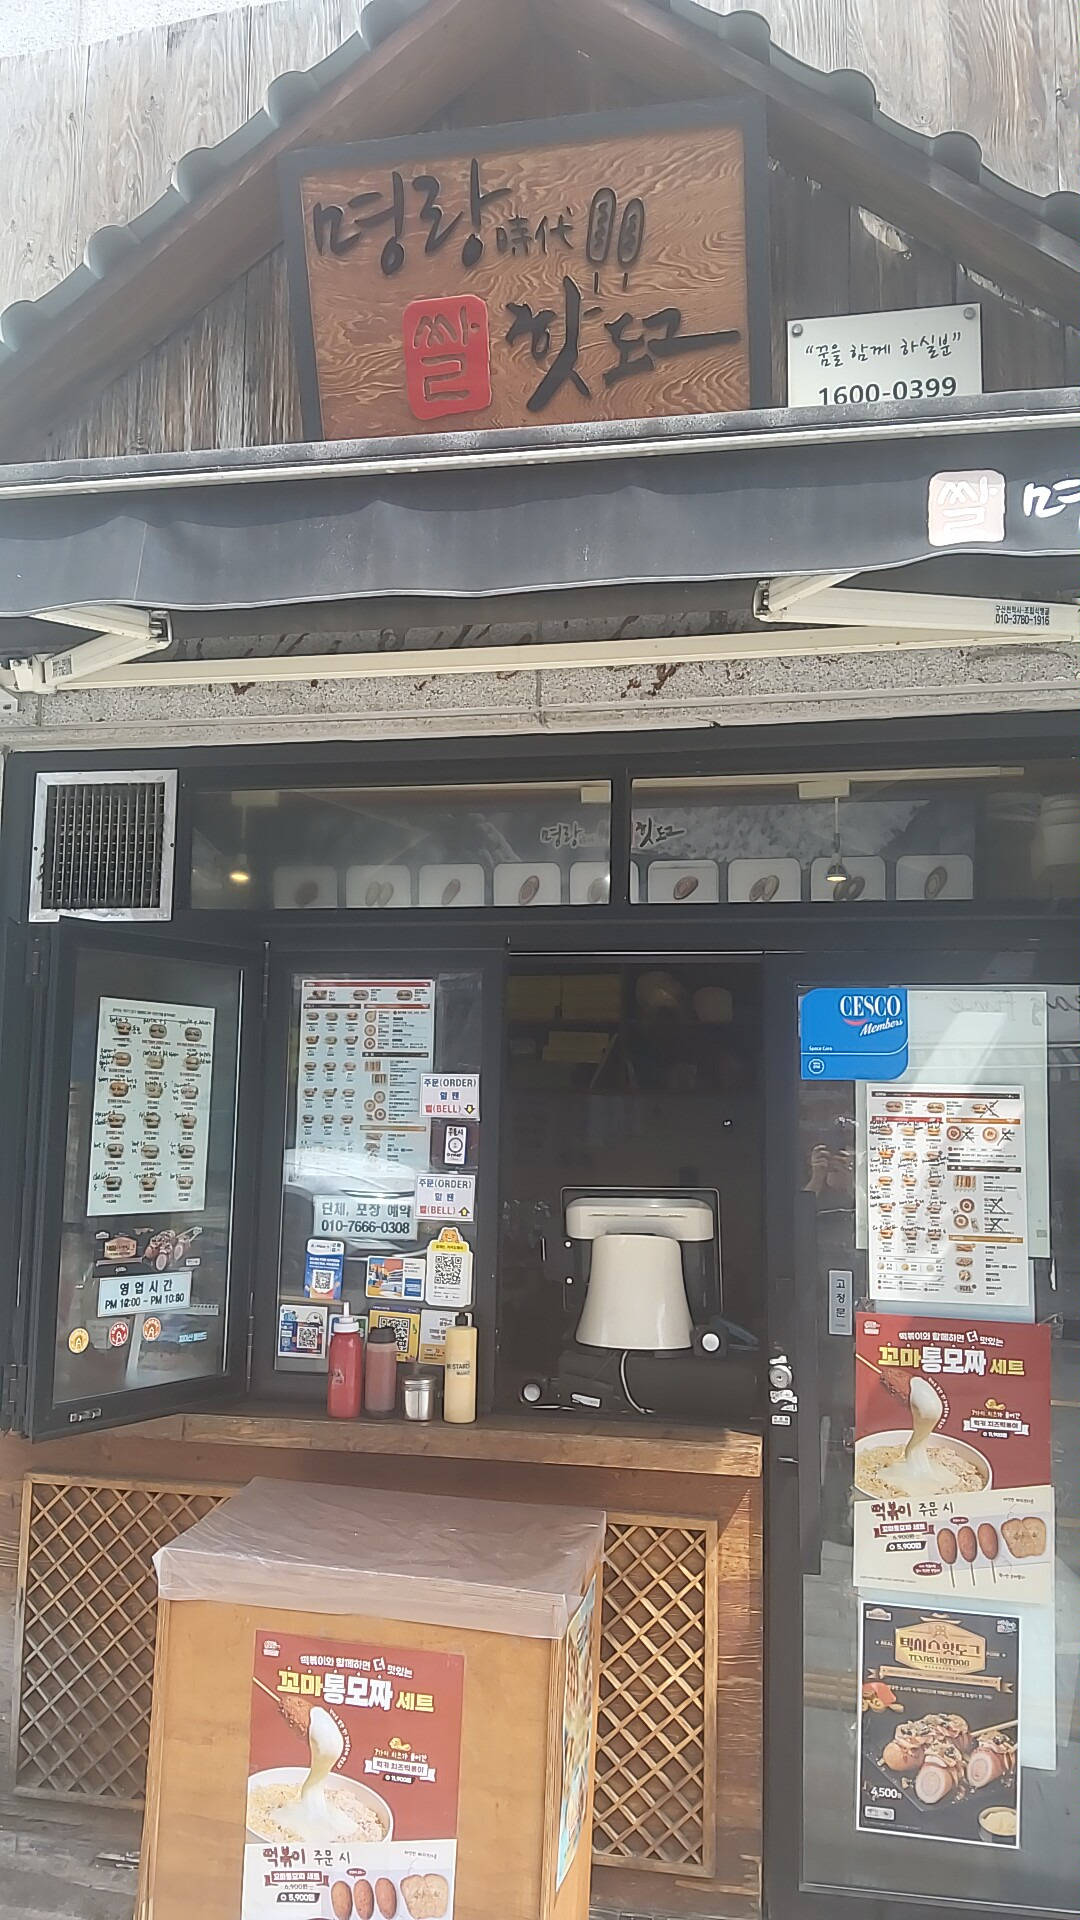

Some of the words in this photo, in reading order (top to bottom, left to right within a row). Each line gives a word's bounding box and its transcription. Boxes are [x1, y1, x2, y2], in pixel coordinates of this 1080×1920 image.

[313, 158, 512, 275] 명랑
[412, 304, 481, 402] 쌀
[505, 275, 741, 412] 핫도그
[849, 343, 891, 363] 함께
[818, 375, 958, 406] 1600-0399
[936, 475, 1000, 534] 쌀
[541, 822, 583, 849] 명랑
[635, 816, 686, 848] 핫도그
[839, 995, 901, 1017] CESCO
[859, 1017, 904, 1037] Members
[424, 1078, 477, 1088] 주문(ORDER)
[425, 1104, 461, 1114] 벨(BELL)
[419, 1178, 472, 1189] 주문(ORDER)
[322, 1202, 349, 1217] 단체,
[356, 1202, 381, 1217] 포장
[387, 1202, 412, 1218] 예약
[419, 1205, 456, 1215] 벨(BELL)
[321, 1219, 410, 1234] 010-7666-0308
[105, 1300, 118, 1310] PM
[150, 1295, 163, 1306] PM
[899, 1332, 931, 1341] 떡볶이와
[932, 1332, 965, 1343] 함께하면
[966, 1330, 979, 1343] 더
[980, 1336, 1004, 1348] 맛있는
[989, 1358, 1026, 1376] 세트
[871, 1501, 912, 1521] 떡볶이
[918, 1502, 938, 1517] 주문
[943, 1502, 954, 1514] 시
[300, 1655, 335, 1667] 떡볶이와
[336, 1657, 371, 1672] 함께하면
[373, 1656, 386, 1671] 더
[387, 1664, 414, 1679] 맛있는
[909, 1654, 935, 1664] TEXAS
[395, 1690, 435, 1713] 세트
[263, 1846, 306, 1868] 떡볶이
[313, 1849, 334, 1866] 주문
[339, 1850, 350, 1864] 시
